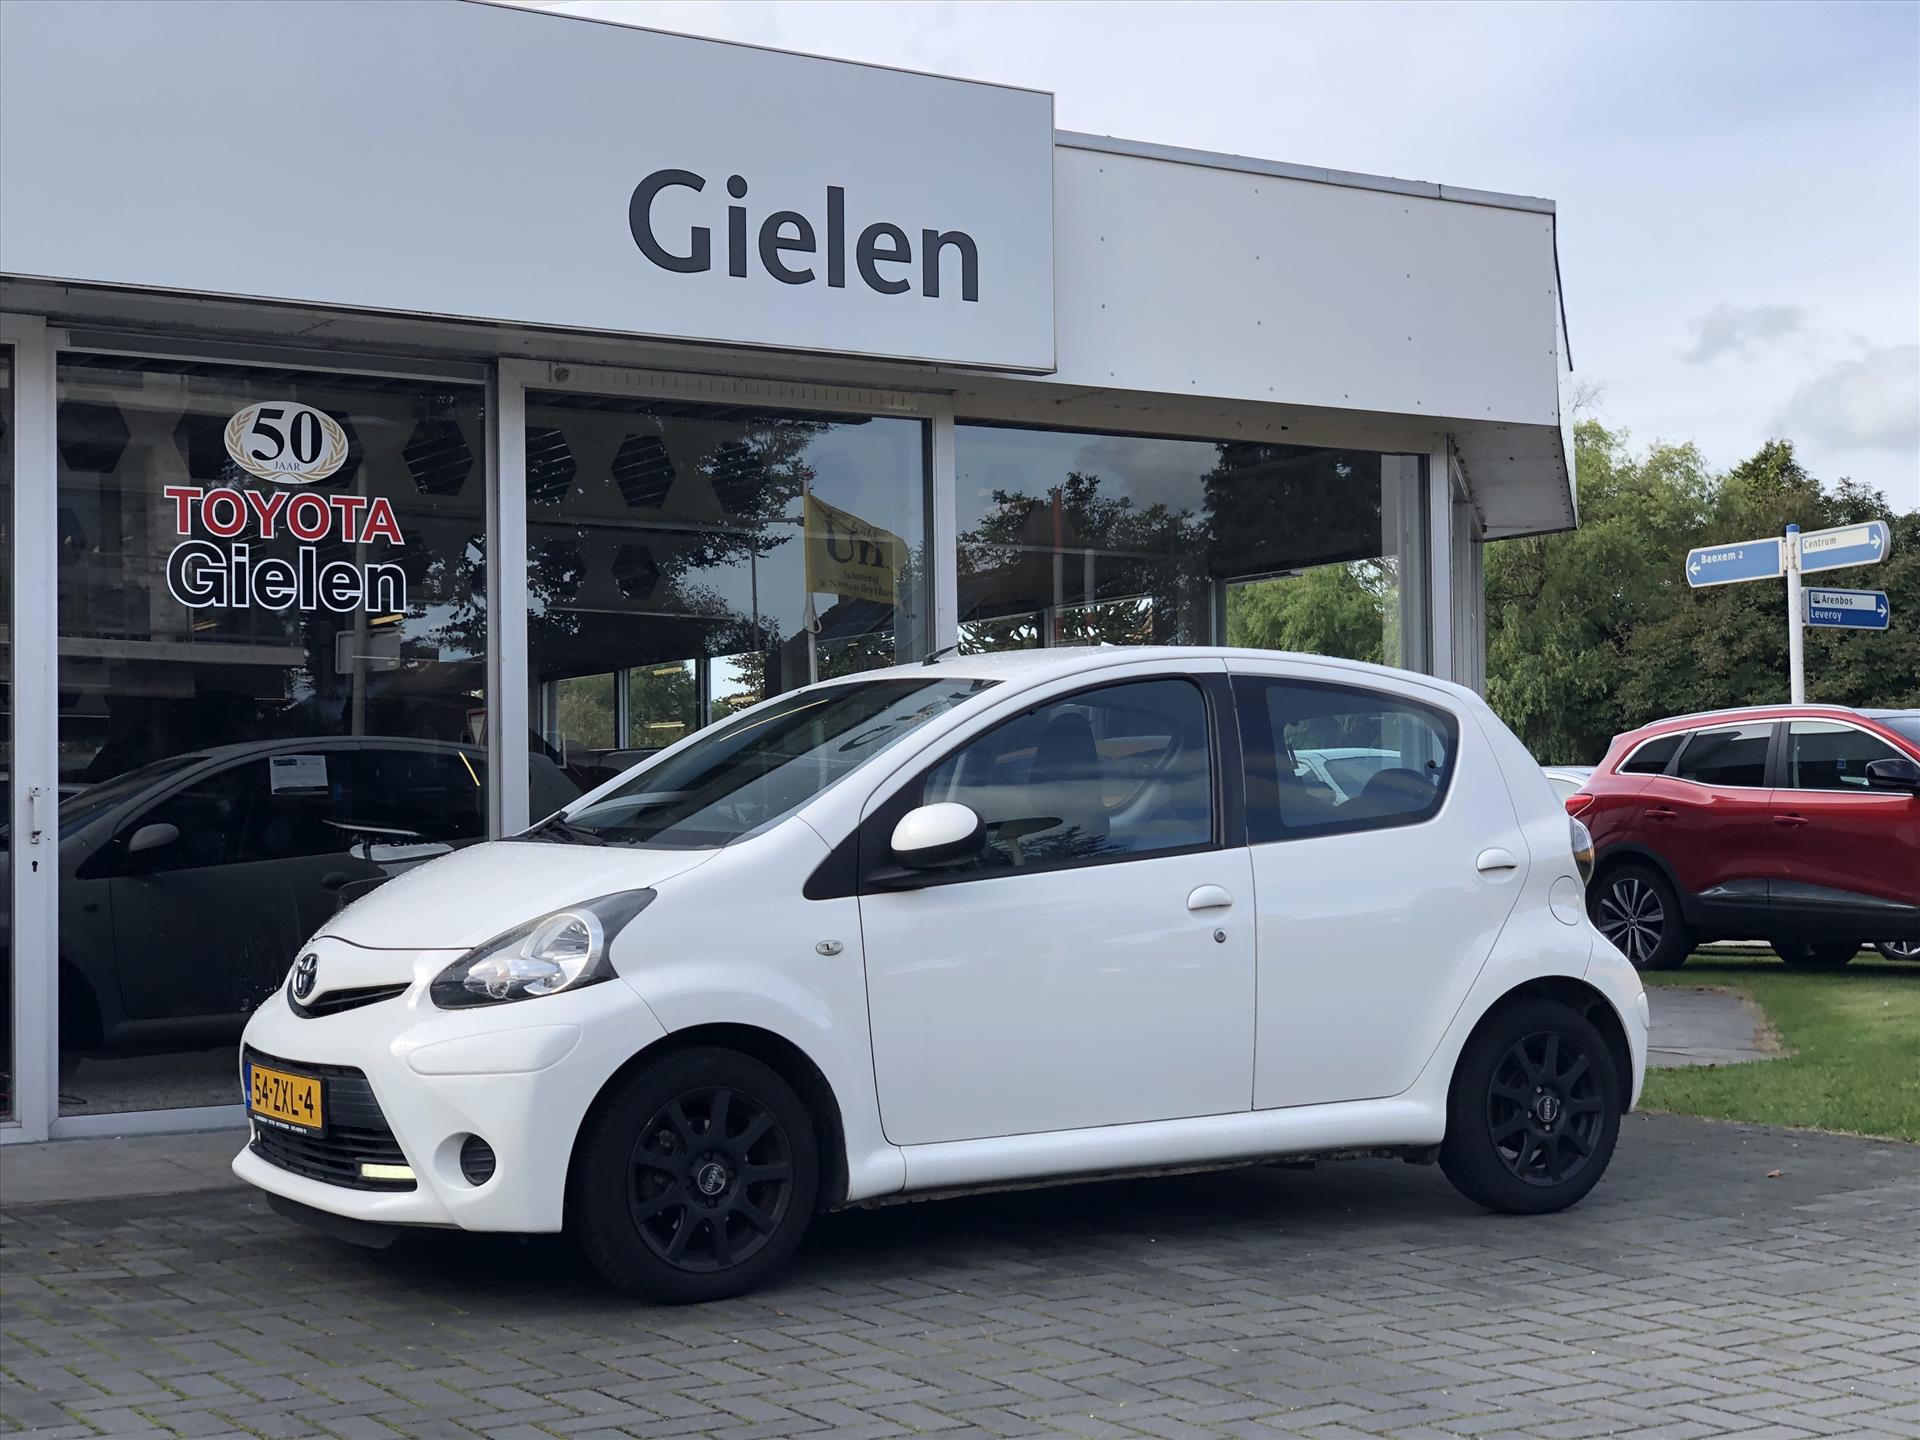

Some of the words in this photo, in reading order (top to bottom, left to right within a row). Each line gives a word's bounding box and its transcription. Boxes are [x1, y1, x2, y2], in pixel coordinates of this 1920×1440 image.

[628, 168, 979, 302] Gielen
[251, 407, 323, 464] 50
[274, 461, 301, 472] JAAR
[164, 485, 405, 545] TOYOTA
[1701, 551, 1736, 564] Baexem
[1738, 550, 1744, 559] 2
[1803, 537, 1837, 549] Centrum
[166, 540, 407, 612] Gielen
[1811, 609, 1842, 622] Leveroy
[1821, 595, 1853, 606] Arenbos
[255, 1072, 314, 1119] 54-ZXL-4
